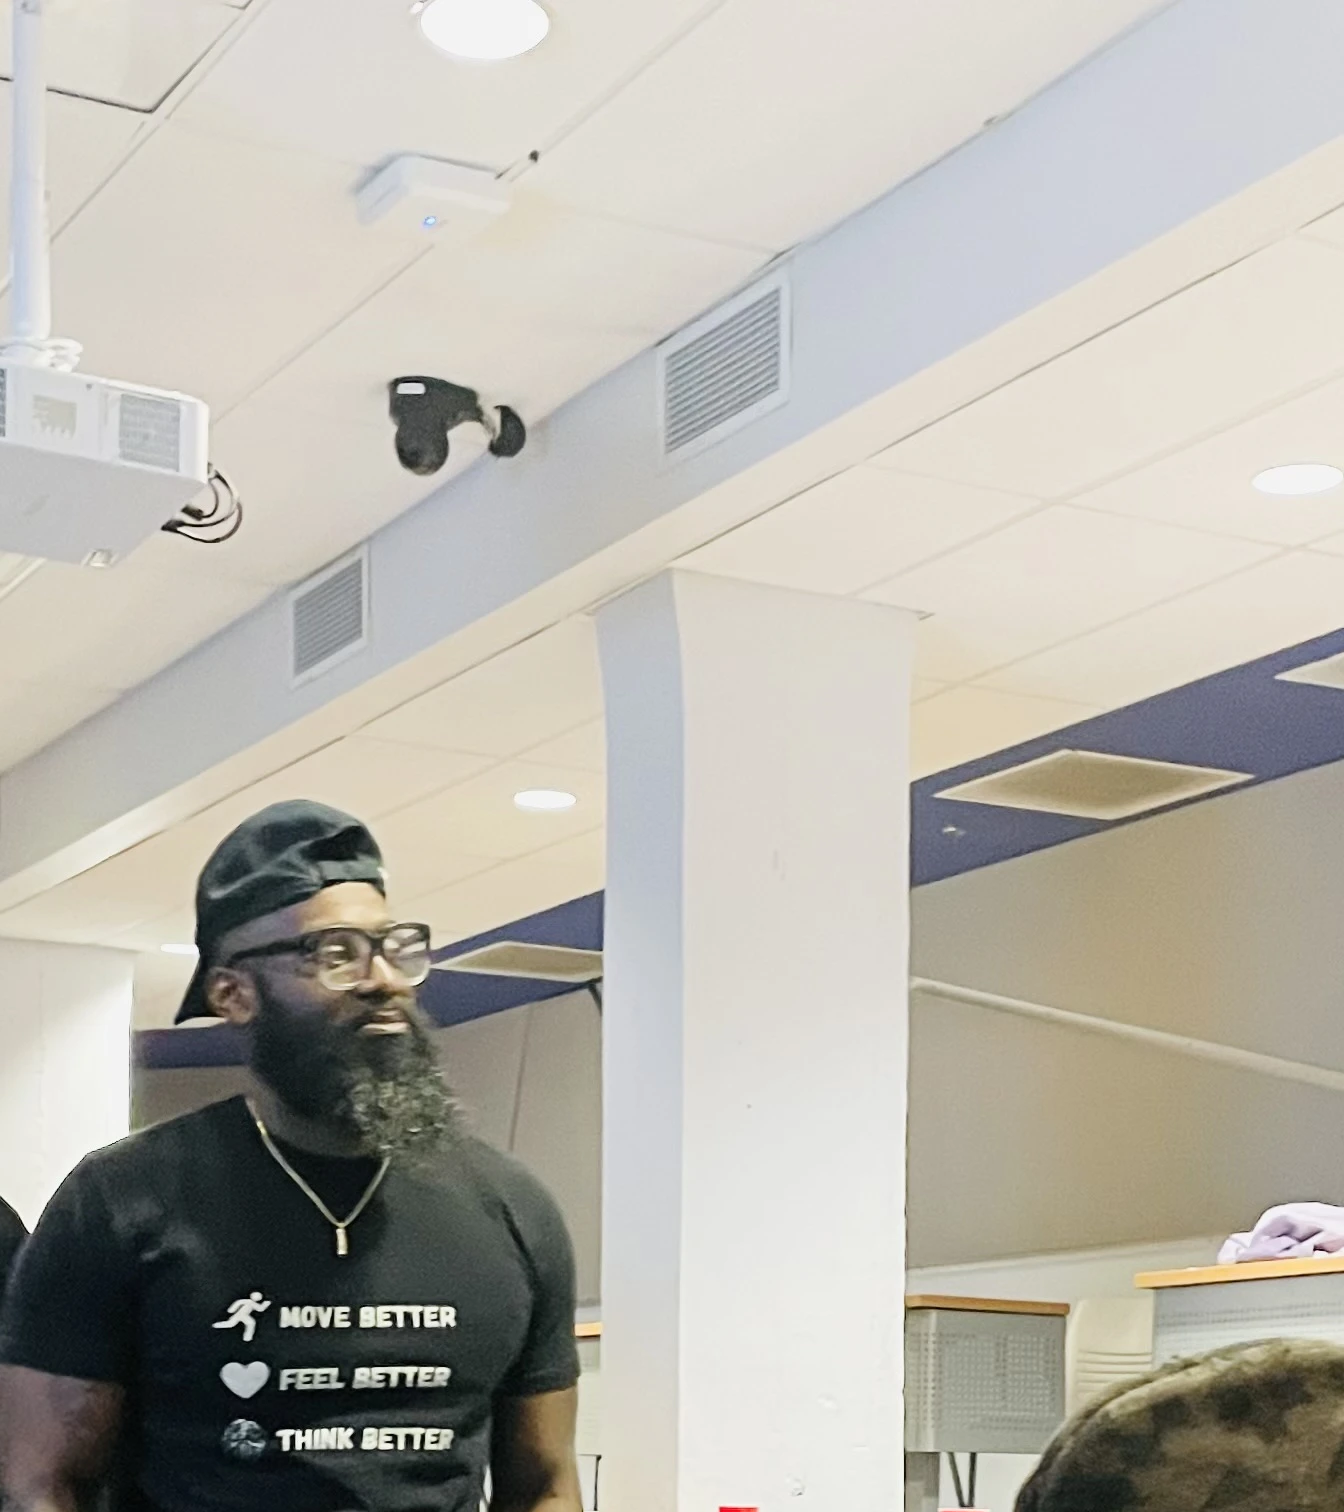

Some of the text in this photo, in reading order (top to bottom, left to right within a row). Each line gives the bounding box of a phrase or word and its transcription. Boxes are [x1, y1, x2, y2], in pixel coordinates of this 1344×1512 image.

[280, 1306, 457, 1328] MOVE BETTER
[280, 1367, 451, 1390] FEEL BETTER
[276, 1428, 454, 1450] THINK BETTER
